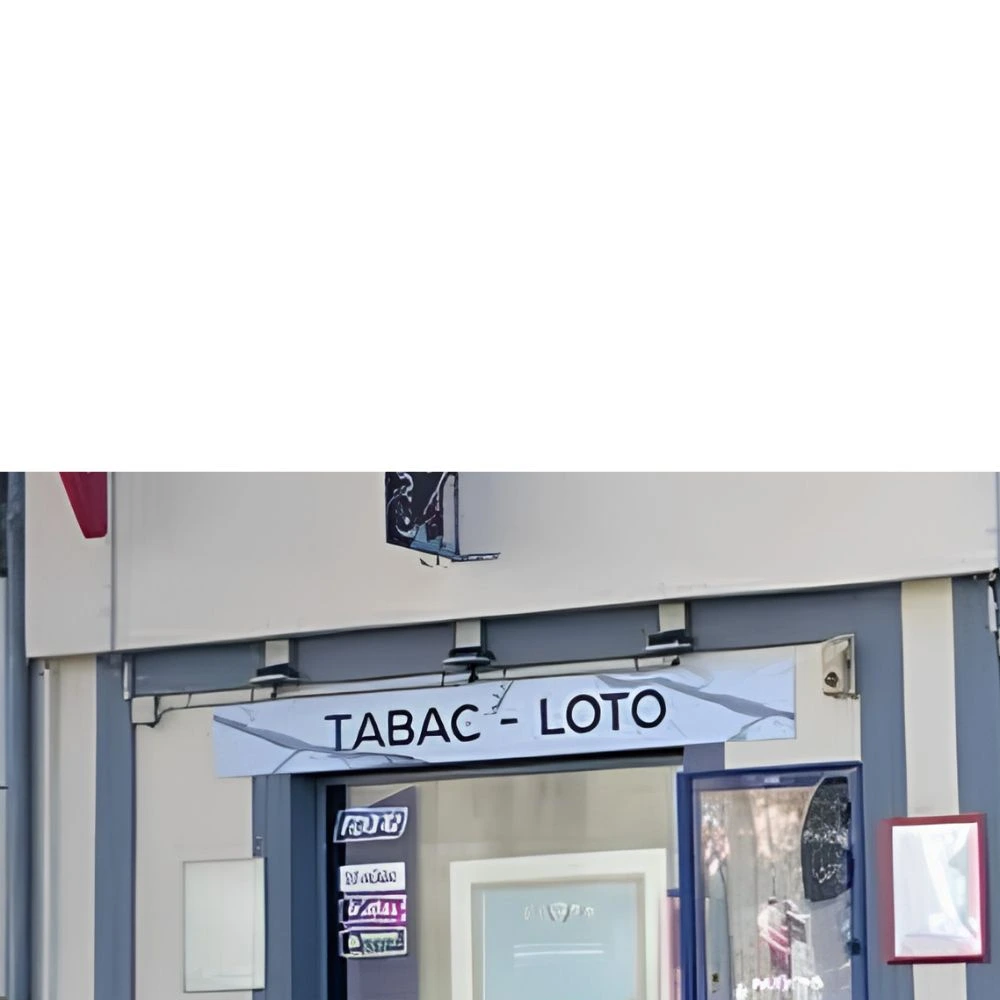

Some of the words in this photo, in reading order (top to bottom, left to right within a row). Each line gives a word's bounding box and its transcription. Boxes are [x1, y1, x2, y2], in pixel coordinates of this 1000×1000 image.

[323, 703, 482, 751] TABAC
[499, 717, 518, 726] -
[539, 688, 667, 736] LOTO
